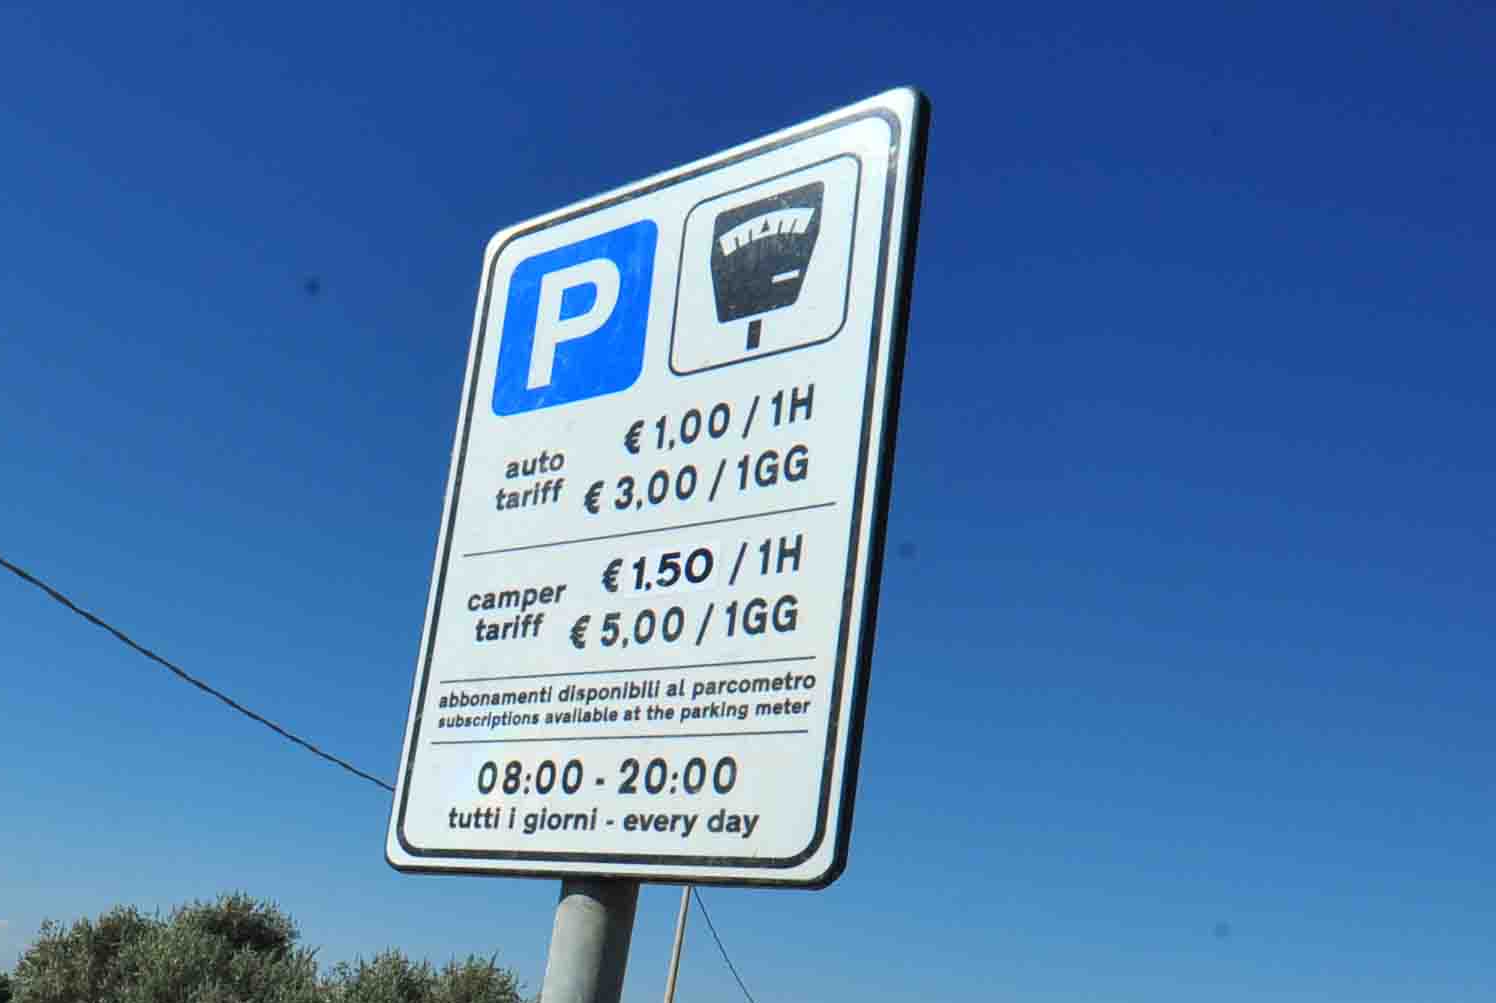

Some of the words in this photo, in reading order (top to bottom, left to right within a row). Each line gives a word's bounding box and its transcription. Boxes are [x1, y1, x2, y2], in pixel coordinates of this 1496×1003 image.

[527, 258, 621, 391] P
[506, 451, 564, 478] auto
[496, 478, 564, 510] tariff
[468, 585, 566, 612] camper
[476, 613, 544, 642] tariff
[439, 686, 552, 708] abbonamenti
[558, 680, 660, 705] disponibili
[666, 679, 684, 696] al
[692, 672, 816, 700] parcometro
[439, 712, 538, 728] subscriptions
[546, 708, 618, 724] available
[624, 706, 641, 721] at
[647, 705, 674, 720] the
[680, 702, 748, 722] parking
[756, 698, 810, 715] meter
[478, 760, 583, 794] 08:00
[618, 757, 737, 794] 20:00
[449, 808, 500, 828] tutti
[509, 807, 515, 829] i
[523, 808, 597, 834] giorni
[624, 814, 698, 837] every
[707, 809, 759, 838] day
